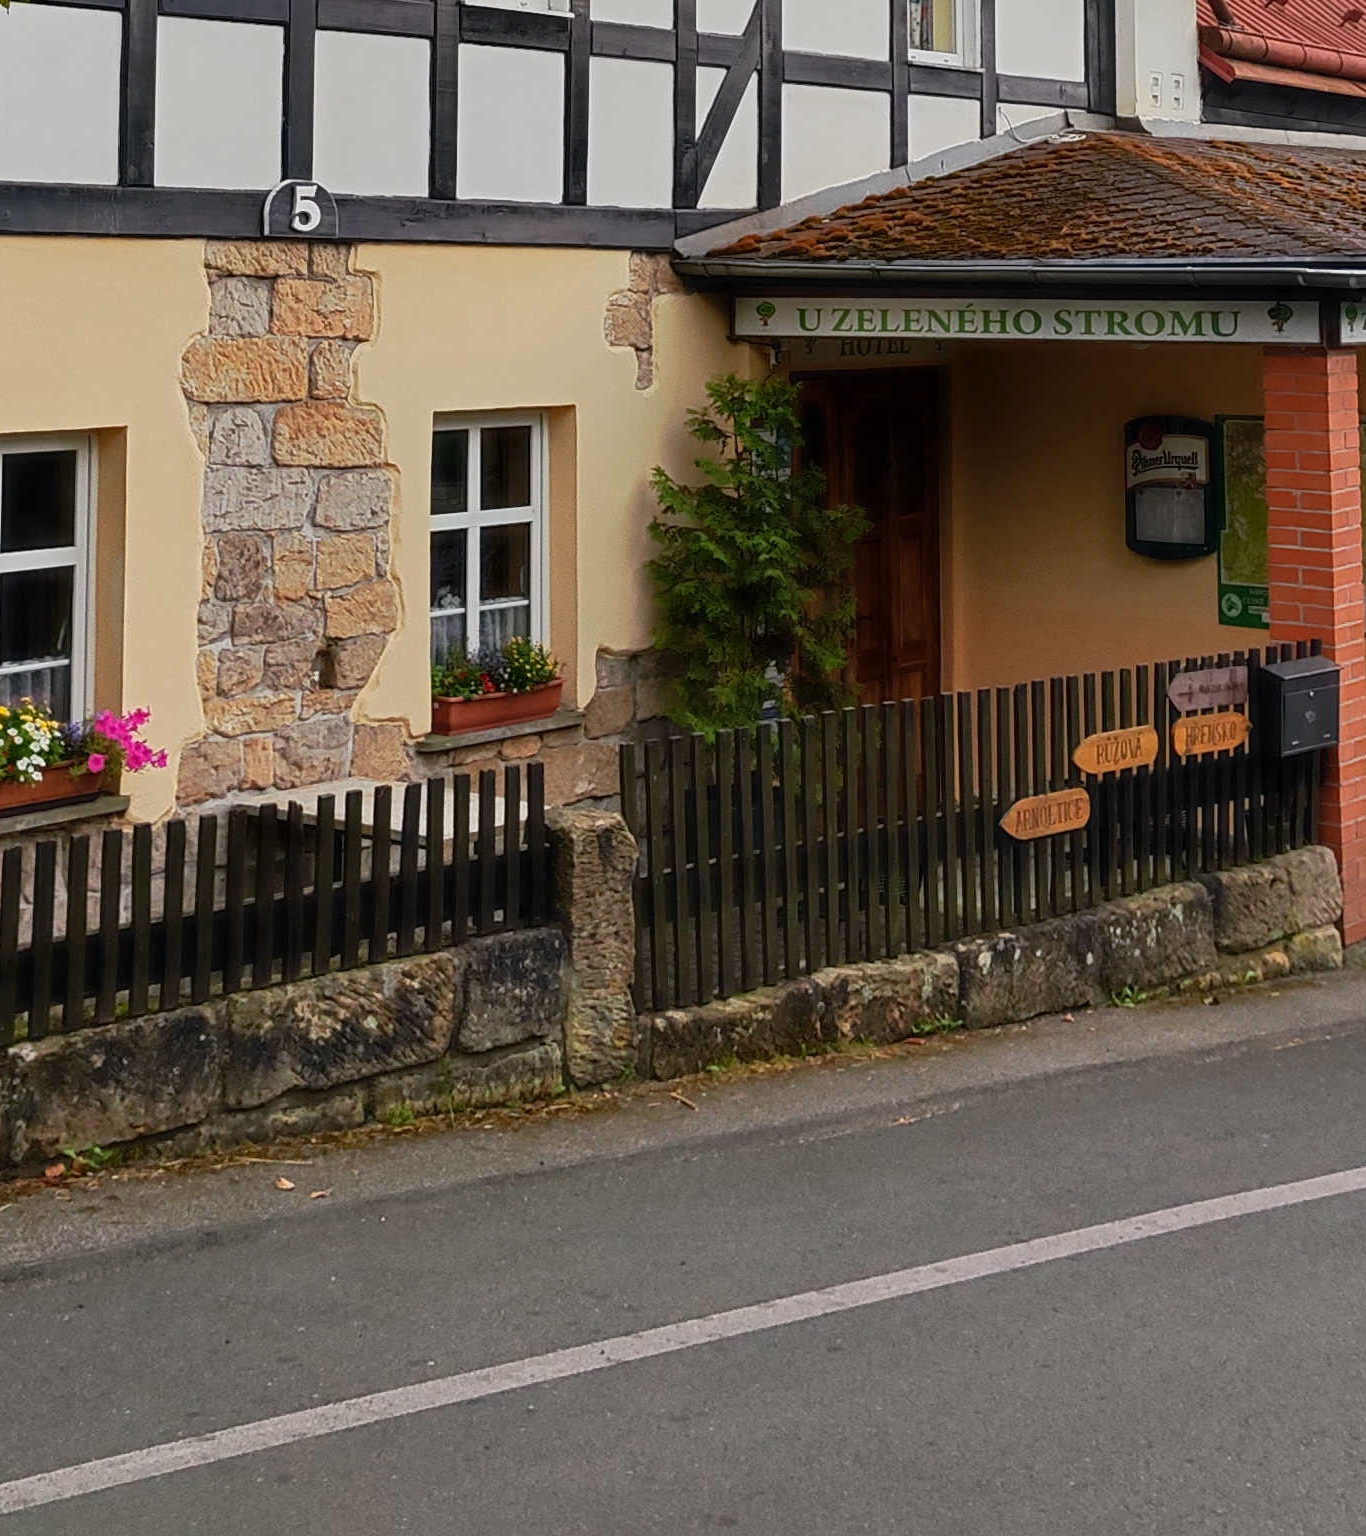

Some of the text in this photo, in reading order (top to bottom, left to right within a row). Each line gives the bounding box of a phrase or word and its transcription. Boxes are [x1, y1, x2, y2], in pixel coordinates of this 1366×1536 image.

[290, 184, 322, 232] 5
[796, 303, 1242, 337] U ZELENÉHO STROMU
[1131, 449, 1199, 476] Pilsner Urquell
[1015, 797, 1084, 834] ARNOLTICE
